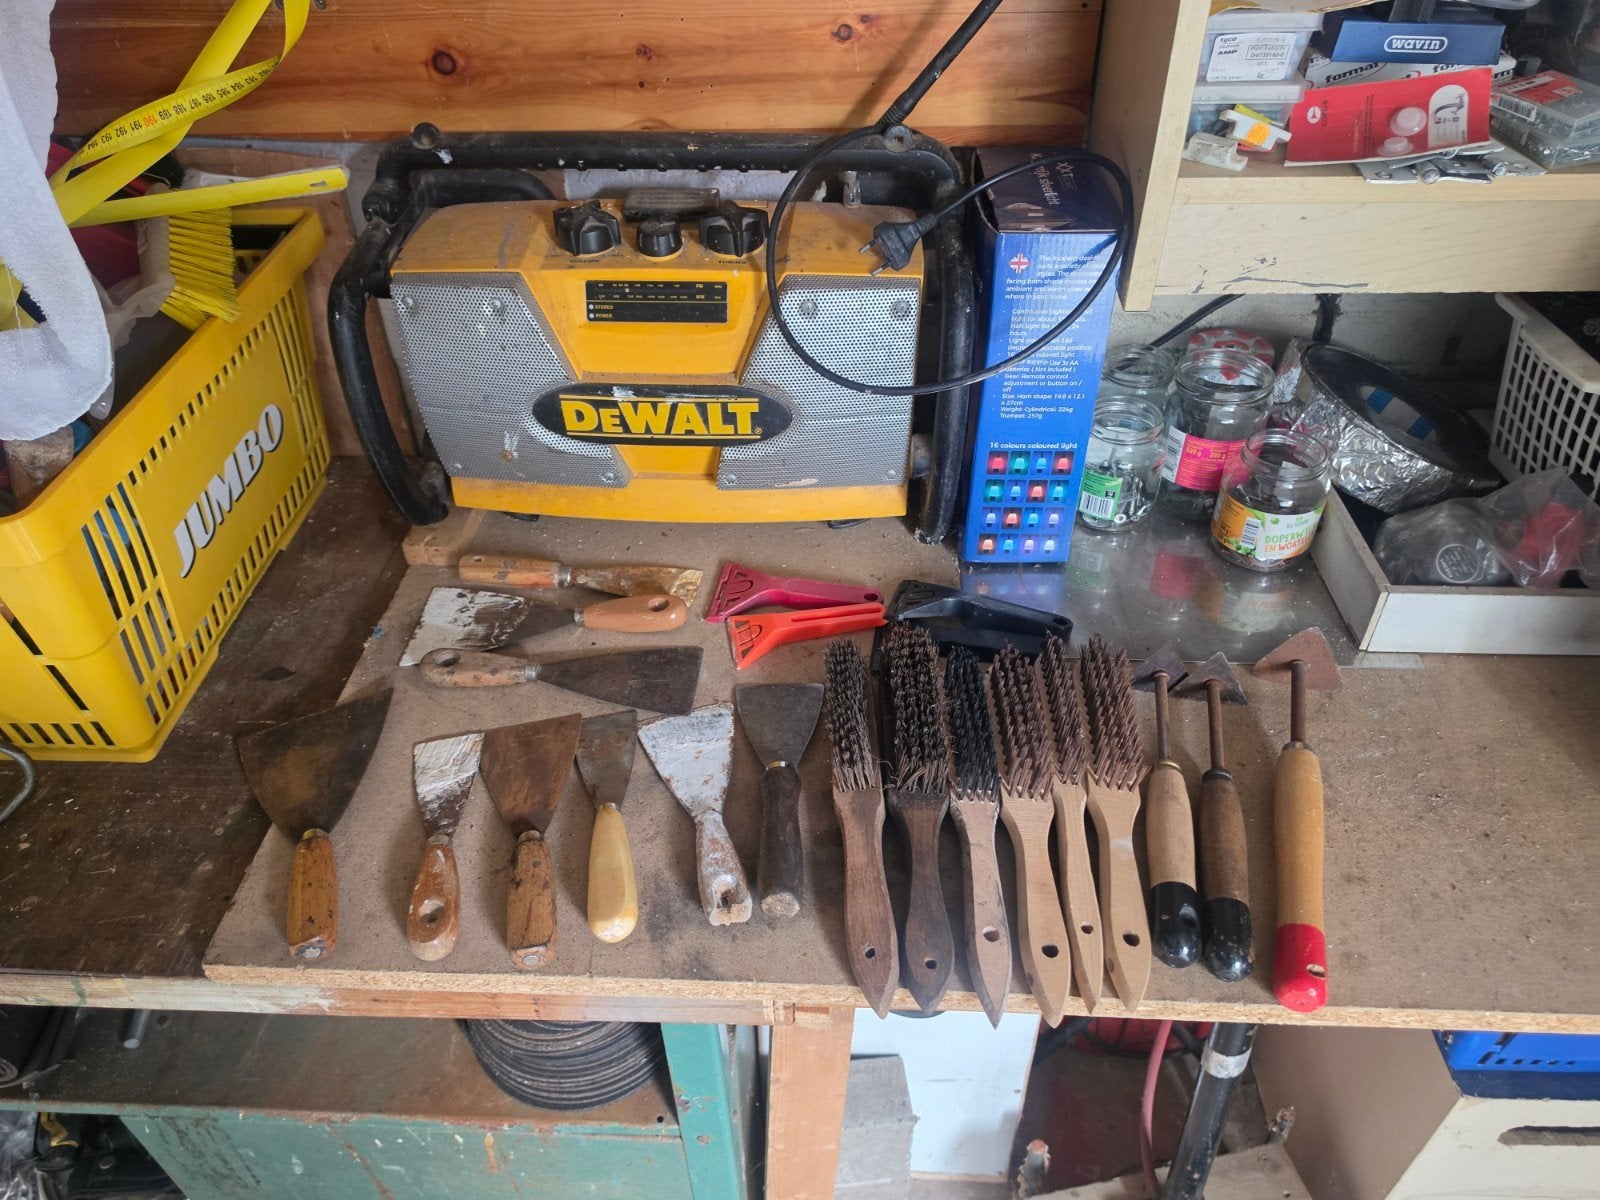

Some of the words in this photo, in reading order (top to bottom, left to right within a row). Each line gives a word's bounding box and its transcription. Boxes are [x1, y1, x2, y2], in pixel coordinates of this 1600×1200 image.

[1391, 38, 1441, 50] wavin
[189, 98, 202, 110] 187
[143, 114, 157, 127] 190
[158, 109, 172, 120] 189
[114, 126, 127, 137] 192
[130, 120, 142, 132] 191
[1060, 442, 1078, 450] light
[174, 404, 284, 579] JUMBO
